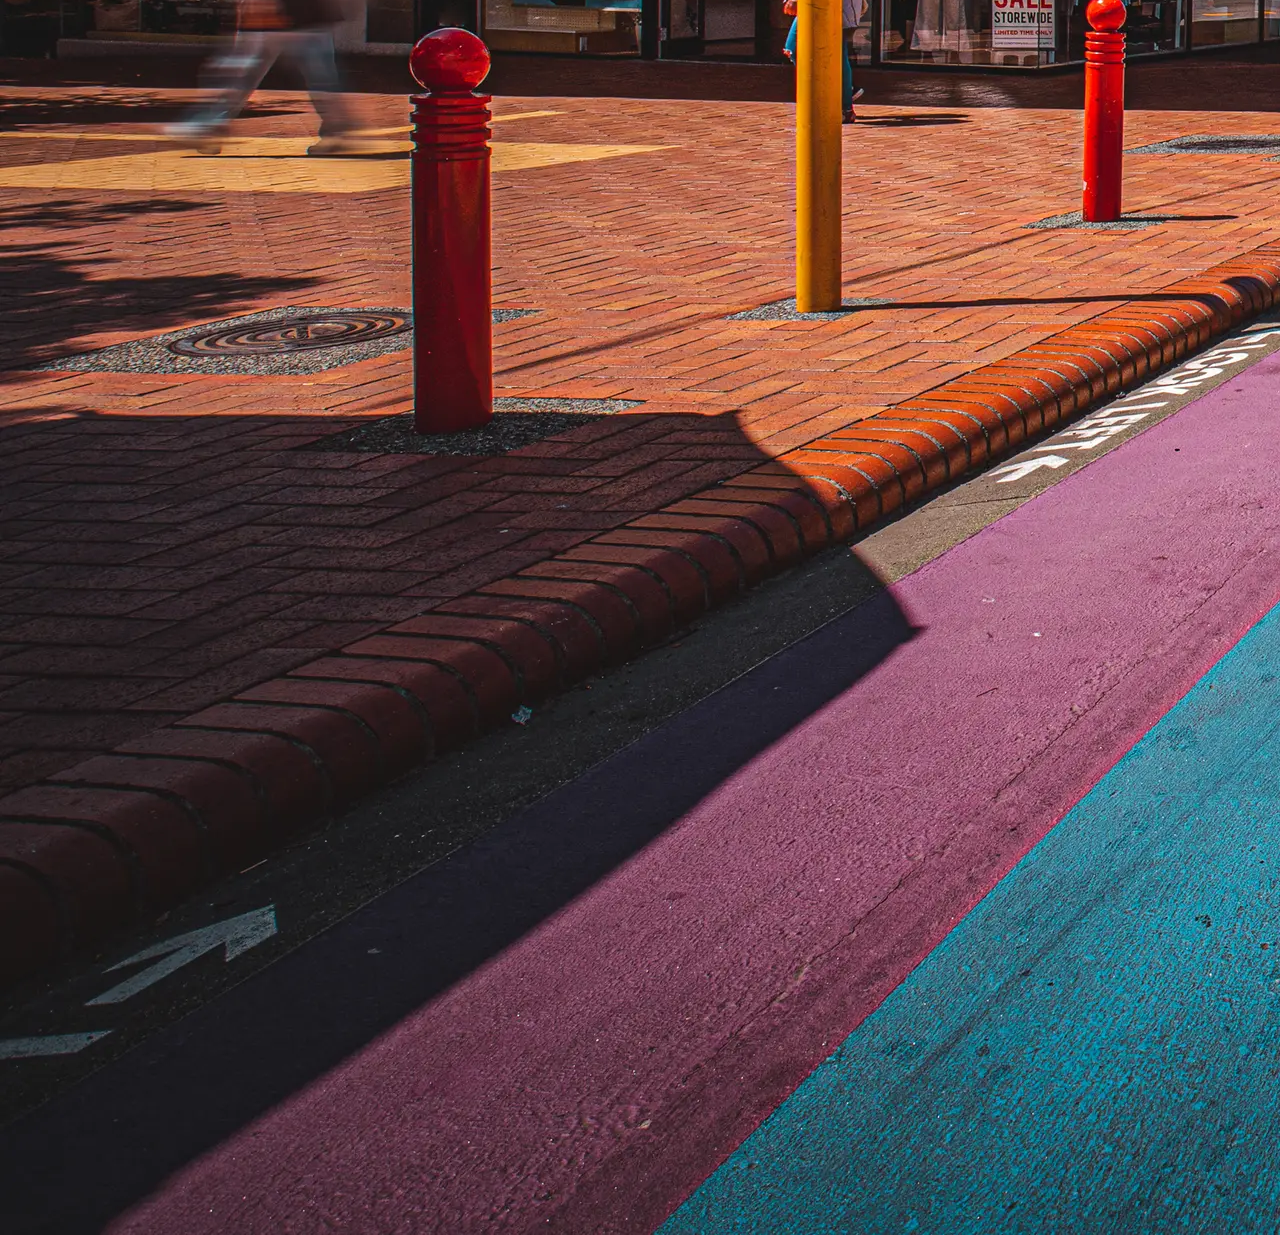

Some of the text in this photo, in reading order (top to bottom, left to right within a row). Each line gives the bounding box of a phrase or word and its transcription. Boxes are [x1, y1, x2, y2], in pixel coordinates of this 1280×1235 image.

[994, 11, 1053, 24] STOREWIDE
[1032, 344, 1267, 453] LOOK LEFT
